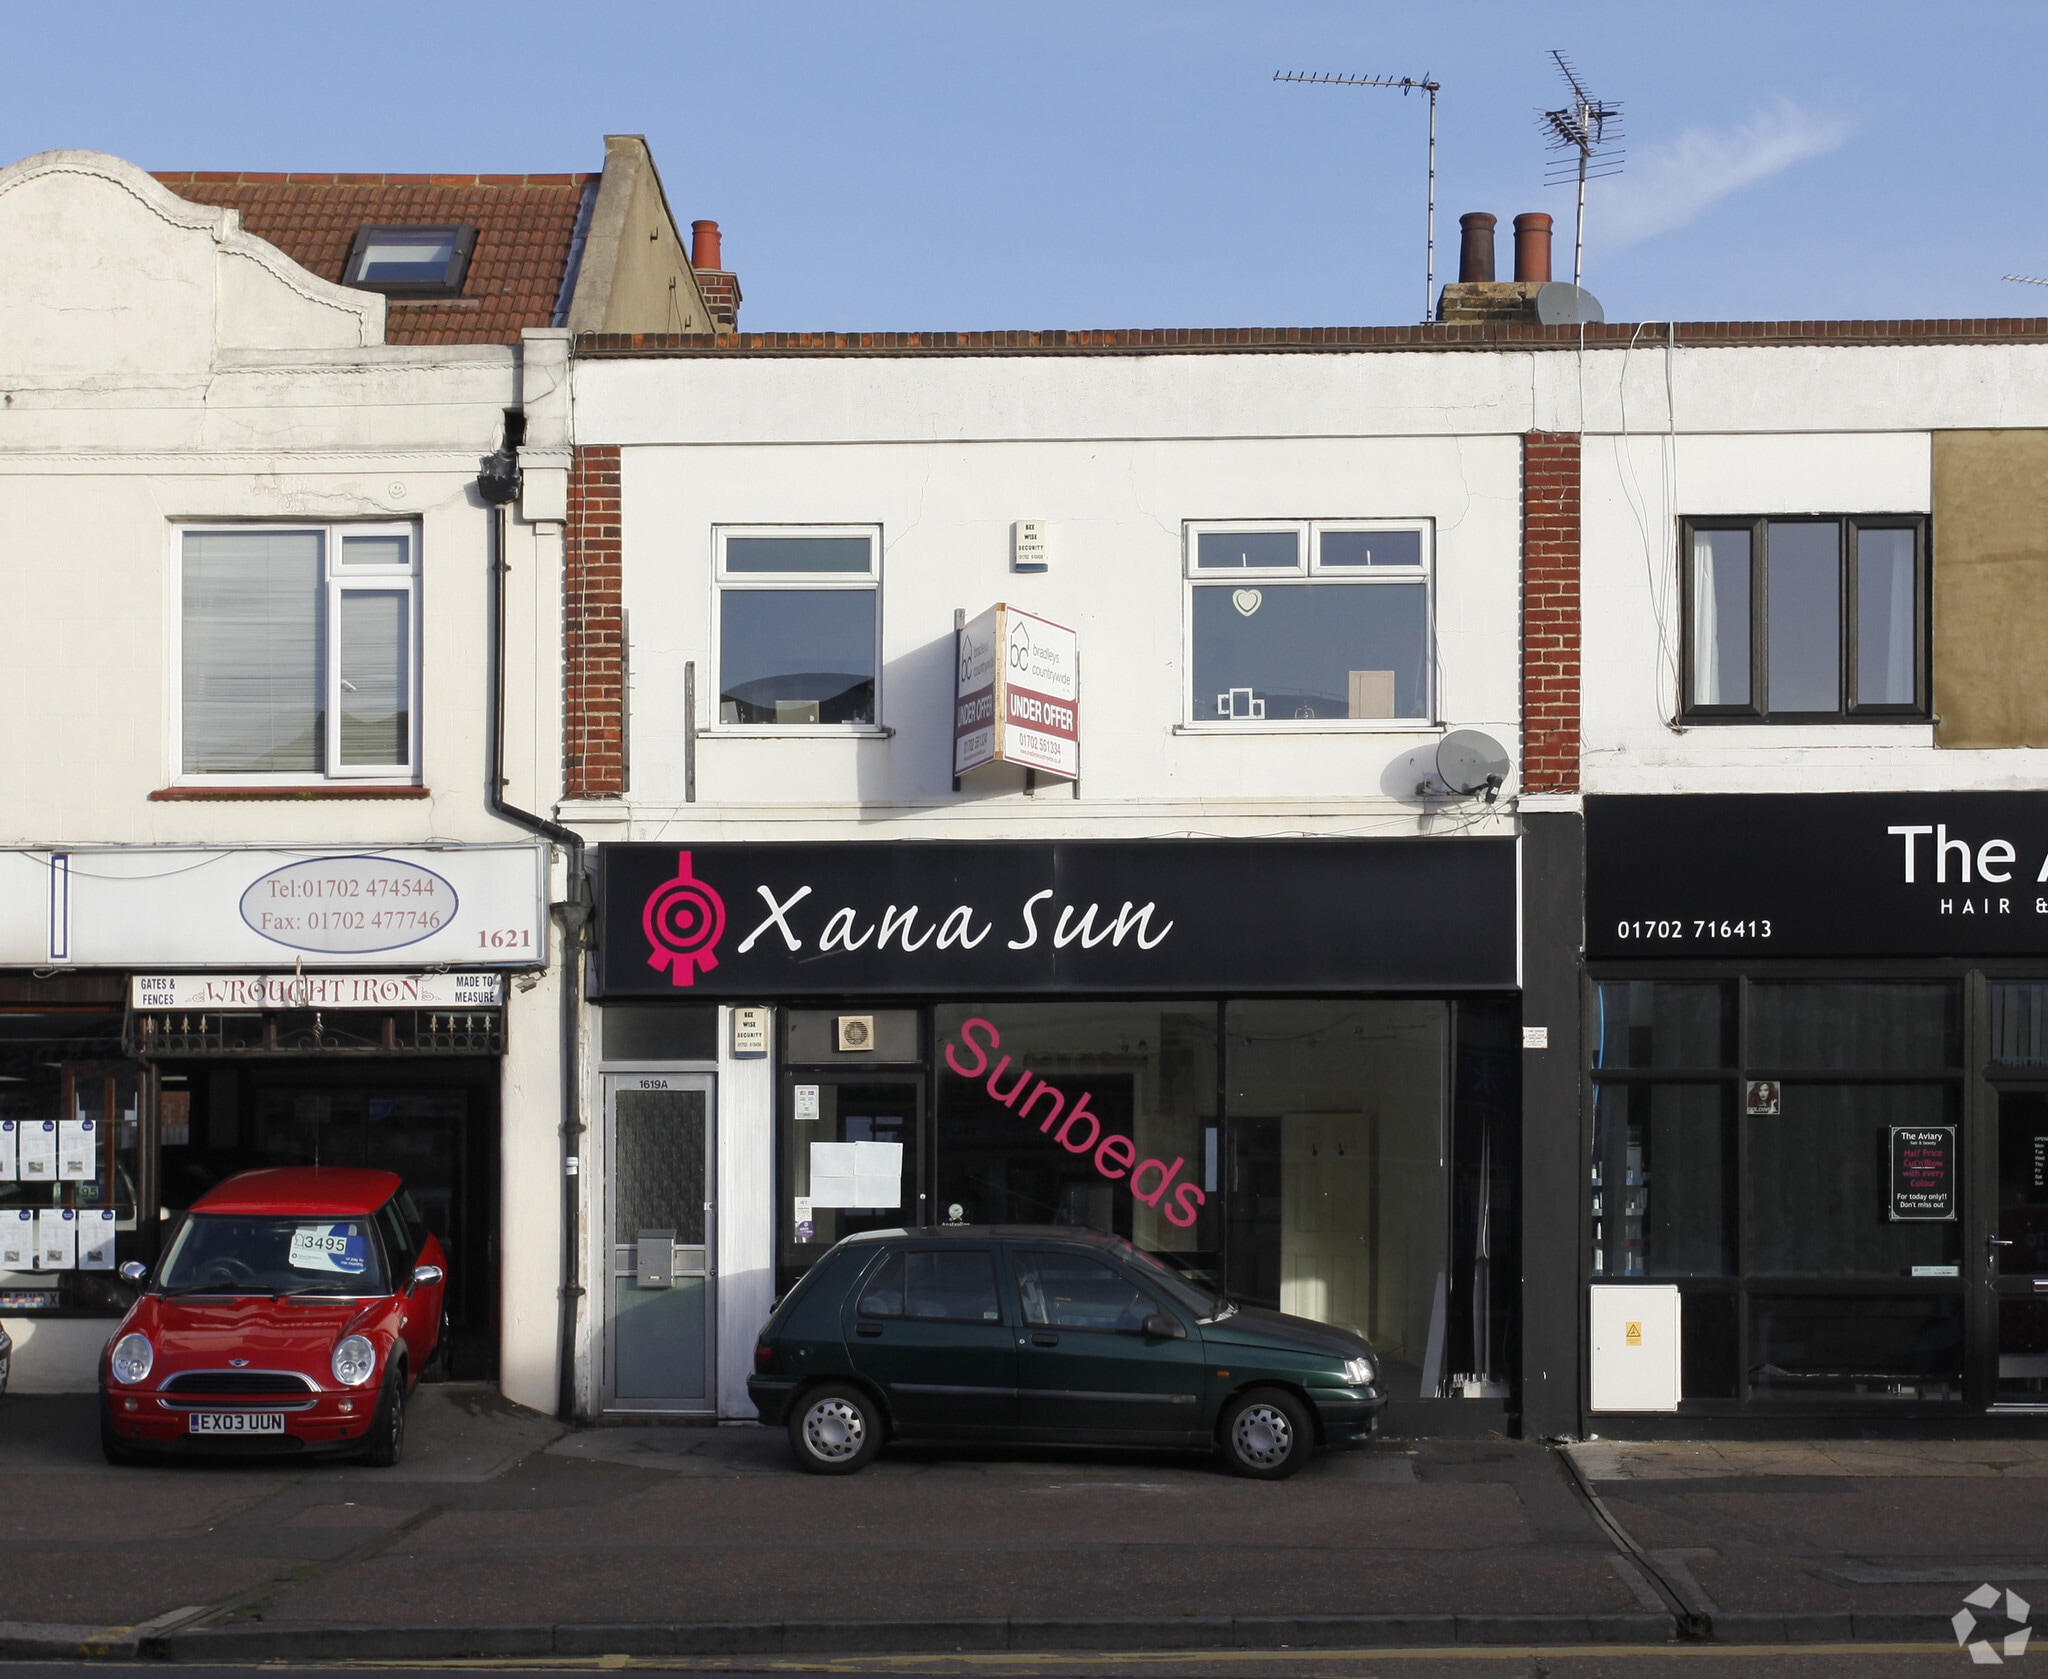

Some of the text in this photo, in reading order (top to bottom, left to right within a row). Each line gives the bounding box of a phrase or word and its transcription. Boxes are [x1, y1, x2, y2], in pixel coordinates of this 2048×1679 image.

[1032, 643, 1061, 666] bradleys
[1031, 664, 1071, 686] countrywide
[957, 693, 994, 728] UNDER OFFER
[1010, 693, 1074, 732] UNDER OFFER
[1019, 732, 1038, 750] 01702
[1039, 739, 1062, 756] 551334
[1887, 823, 2017, 884] The
[366, 878, 435, 897] 474544
[1940, 897, 2011, 914] HAIR
[261, 910, 441, 930] Fax: 01702 477746
[737, 884, 1174, 955] Xana Sun
[1617, 919, 1772, 939] 01702 716413
[477, 929, 531, 949] 1621
[141, 978, 176, 990] GATES &
[205, 977, 421, 1004] WROUGHT IRON
[456, 976, 494, 988] MADE TO
[142, 993, 174, 1006] FENCES
[455, 991, 495, 1004] MEASURE
[639, 1079, 669, 1089] 1619A
[943, 1016, 1206, 1230] Sunbeds
[1901, 1132, 1943, 1142] The Aviary
[1904, 1149, 1943, 1157] Half Price
[1910, 1179, 1936, 1187] Colour
[1922, 1171, 1944, 1179] every
[1909, 1193, 1928, 1201] today
[1928, 1192, 1947, 1201] only!!
[201, 1415, 282, 1430] EX03 UUN
